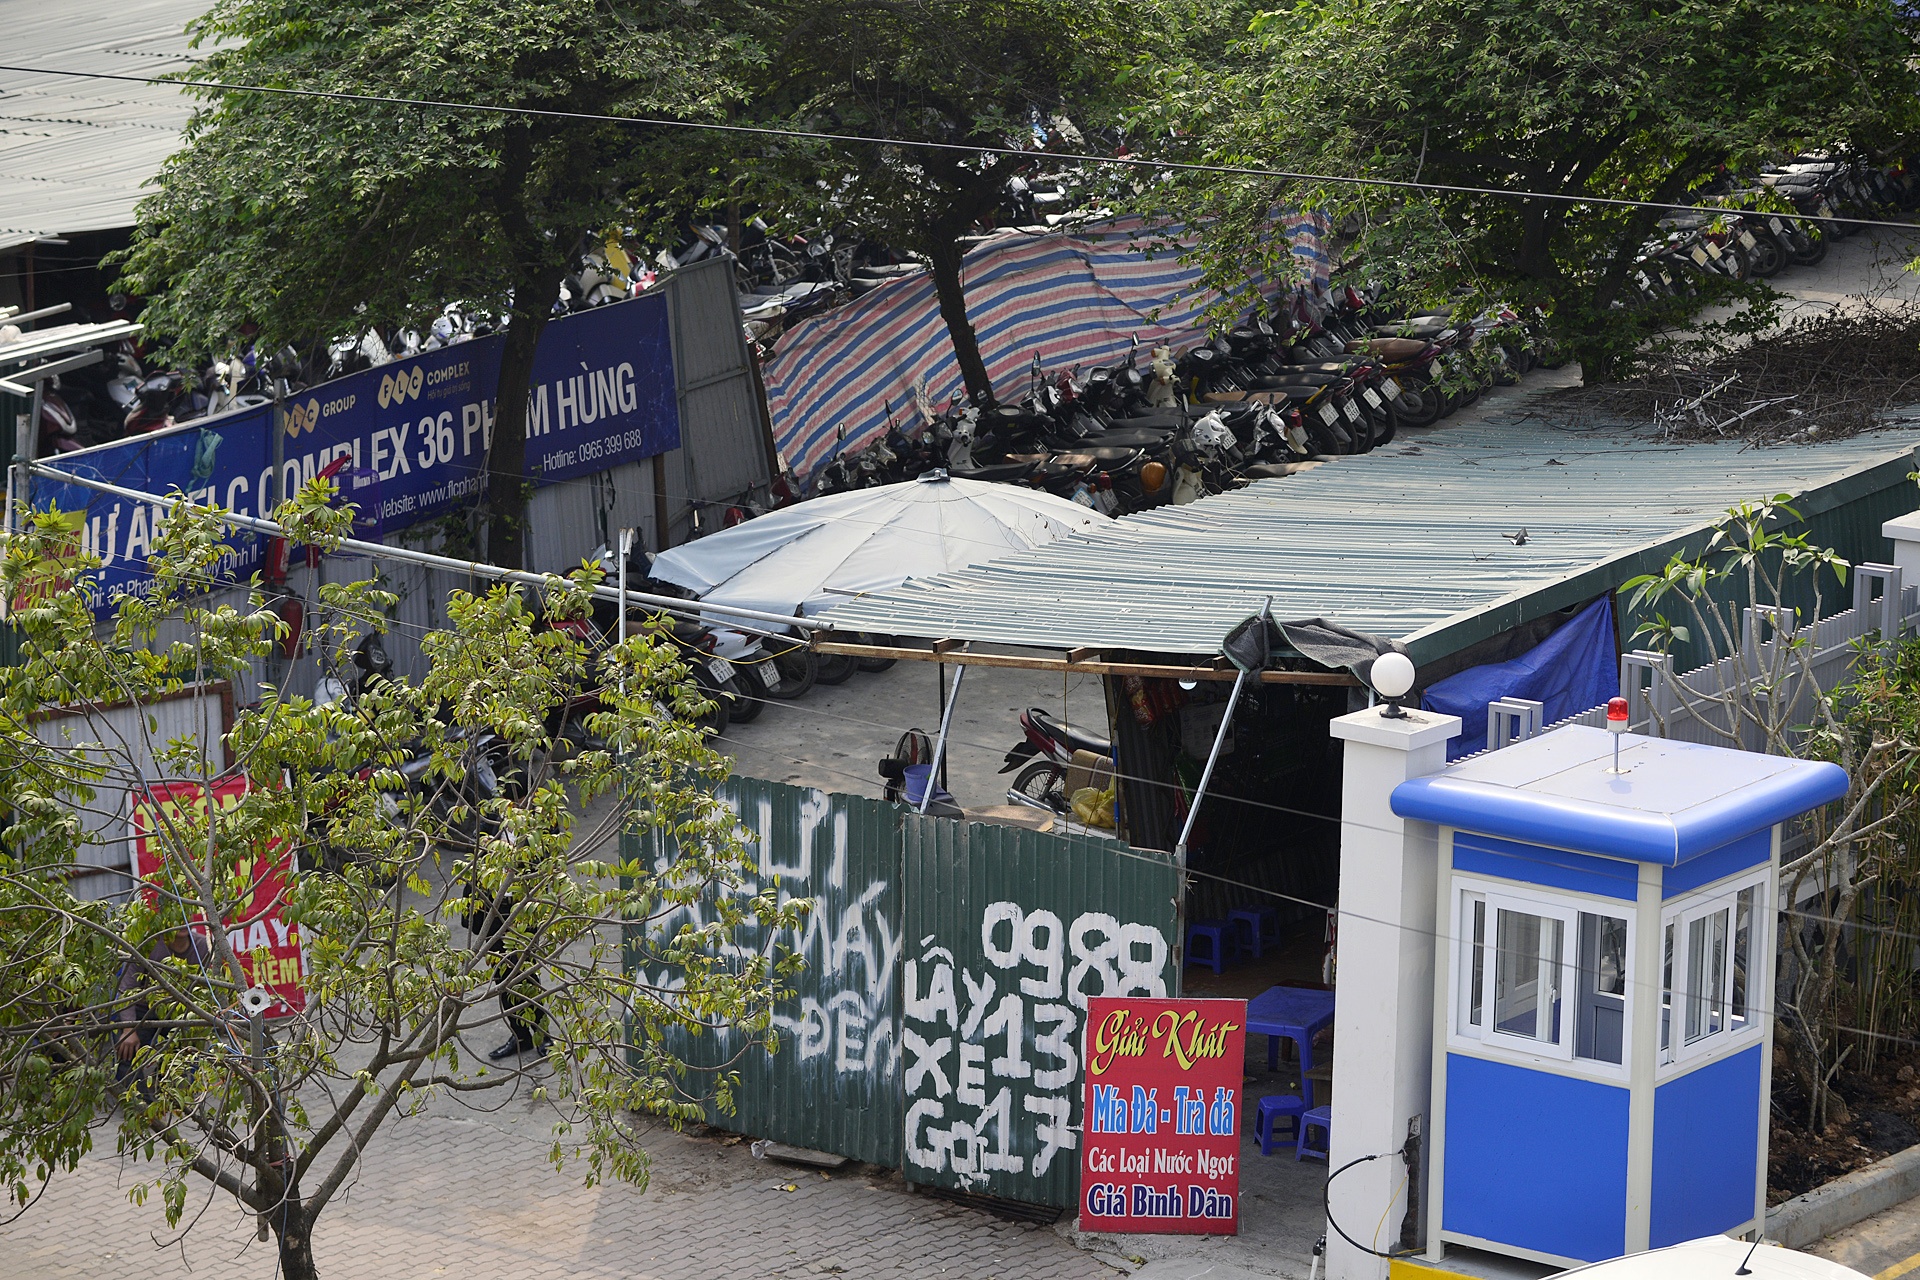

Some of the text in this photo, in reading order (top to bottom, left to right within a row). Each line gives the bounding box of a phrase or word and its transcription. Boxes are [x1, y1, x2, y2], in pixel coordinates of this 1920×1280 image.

[427, 361, 470, 386] COMPLEX
[322, 394, 356, 418] GROUP
[417, 411, 454, 469] 36
[462, 383, 550, 456] PHM
[556, 361, 638, 431] HÙNG
[543, 428, 642, 471] Hotline: 0965 399 688
[1091, 1009, 1240, 1075] Giải Khát
[903, 1027, 986, 1110] XE
[1091, 1084, 1127, 1134] Mía
[1130, 1085, 1158, 1134] Đá
[1174, 1086, 1206, 1135] Trà
[1210, 1086, 1235, 1136] đá
[1088, 1146, 1235, 1181] Các Loại Nước Ngọt
[1086, 1183, 1233, 1219] Giá Bình Dân
